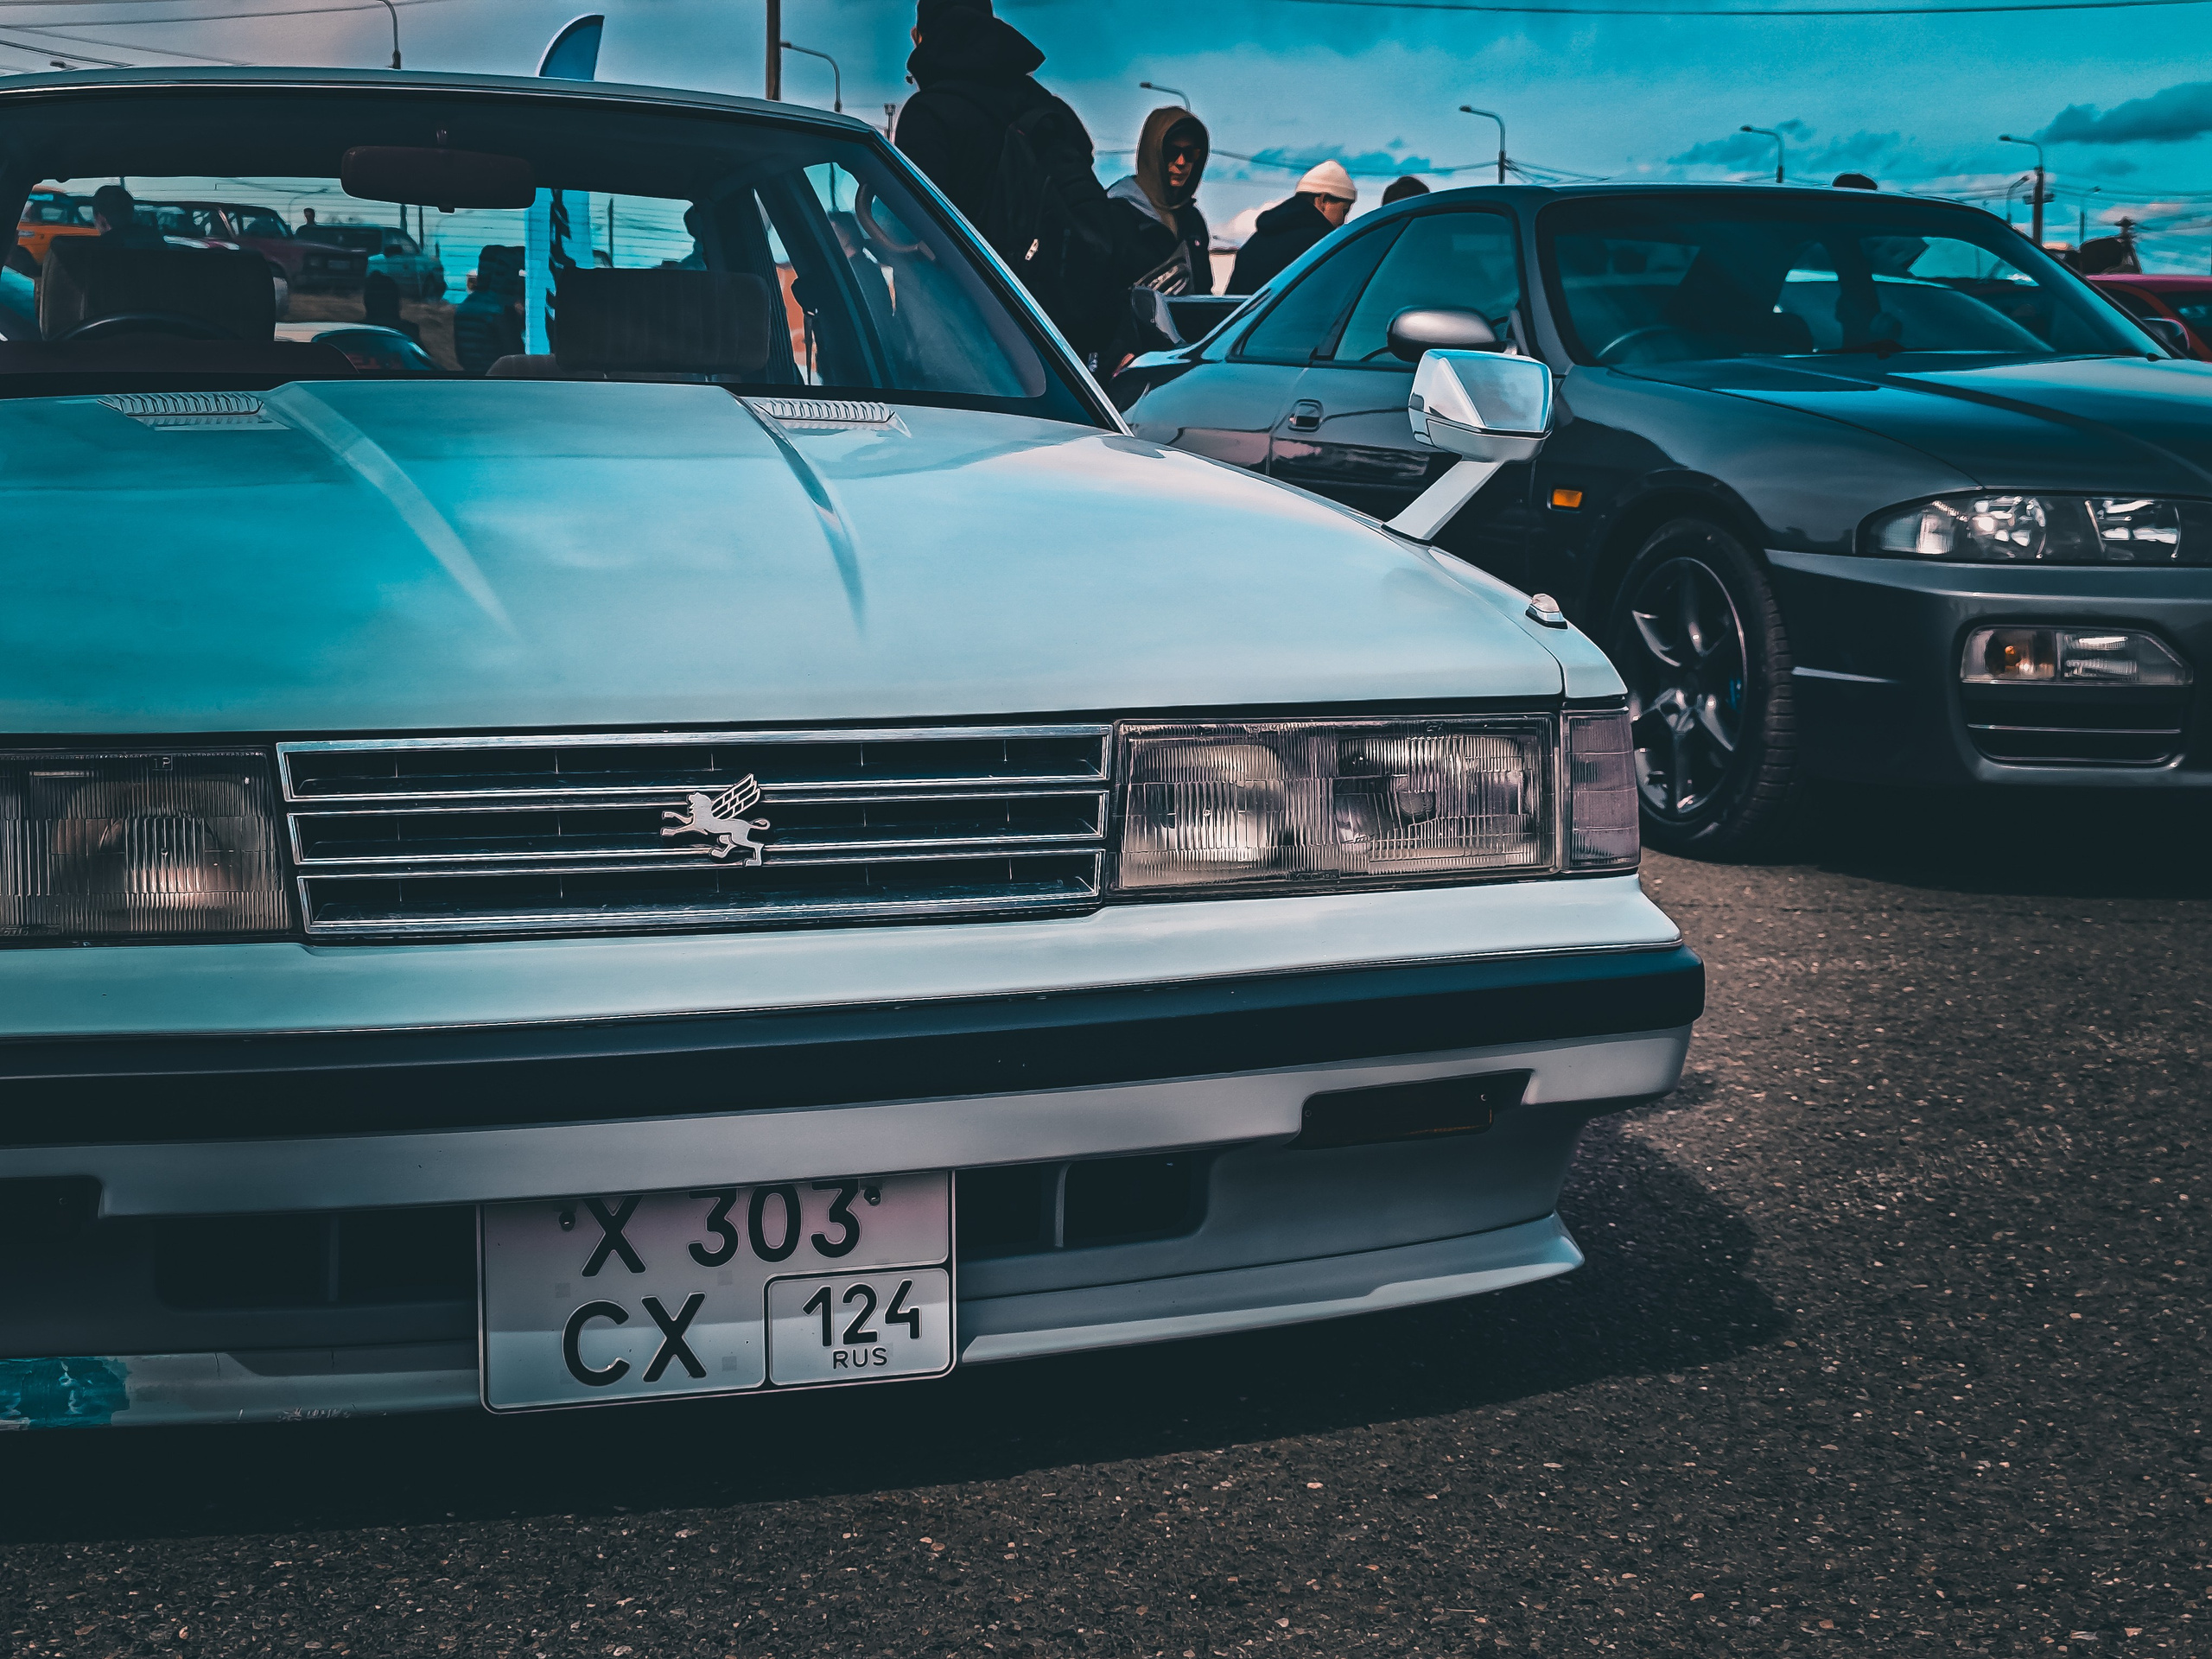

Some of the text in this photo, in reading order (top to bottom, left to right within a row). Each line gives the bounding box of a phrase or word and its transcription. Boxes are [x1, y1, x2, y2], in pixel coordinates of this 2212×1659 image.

[582, 1184, 861, 1276] X 303
[563, 1293, 707, 1387] CX
[803, 1279, 920, 1347] 124
[832, 1347, 887, 1370] RUS
